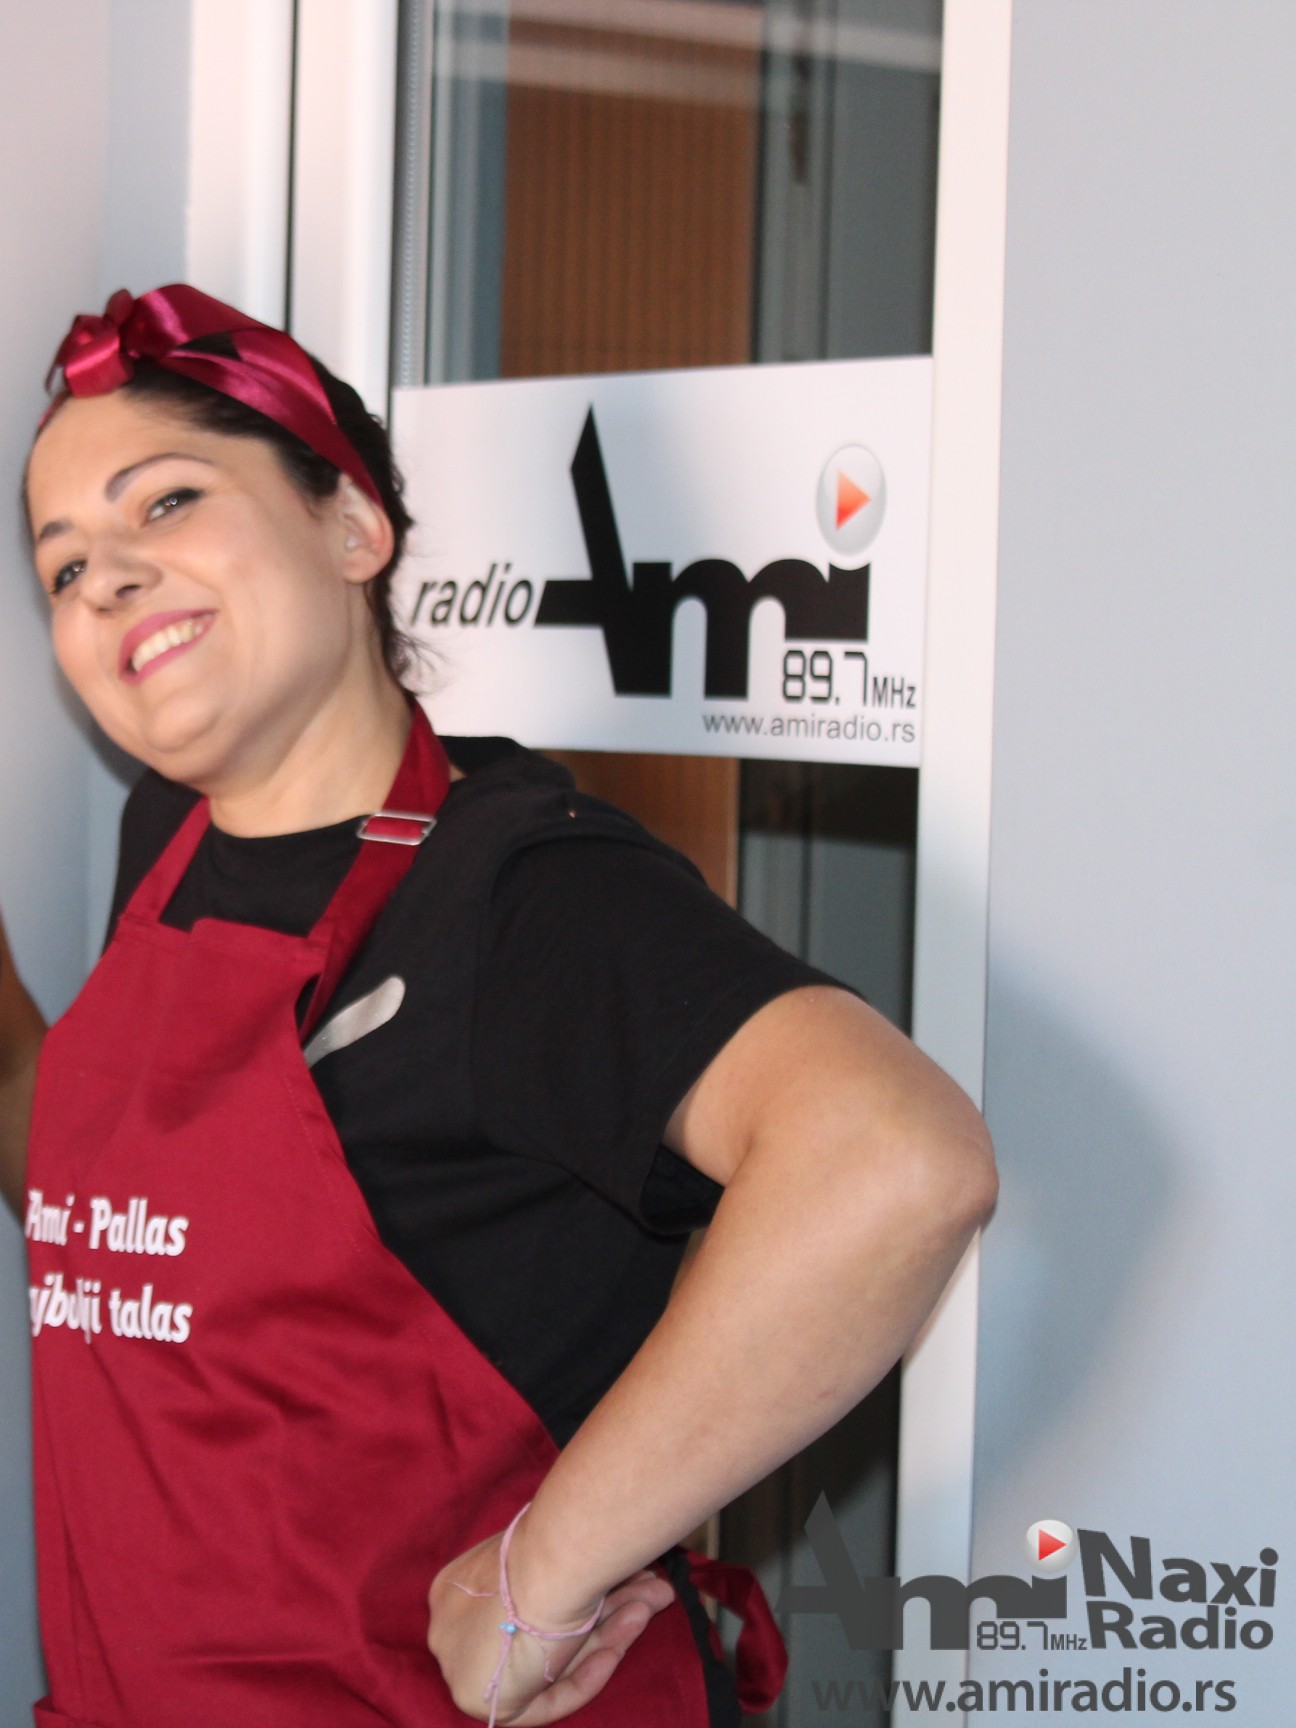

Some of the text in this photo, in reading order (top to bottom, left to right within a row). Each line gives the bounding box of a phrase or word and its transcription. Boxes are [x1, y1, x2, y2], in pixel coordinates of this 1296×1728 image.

[410, 562, 534, 630] radio
[782, 650, 917, 708] 89.7 MHz
[703, 713, 916, 743] www.amiradio.rs
[26, 1187, 75, 1246] Ami
[88, 1196, 189, 1257] Pallas
[109, 1283, 193, 1343] talas
